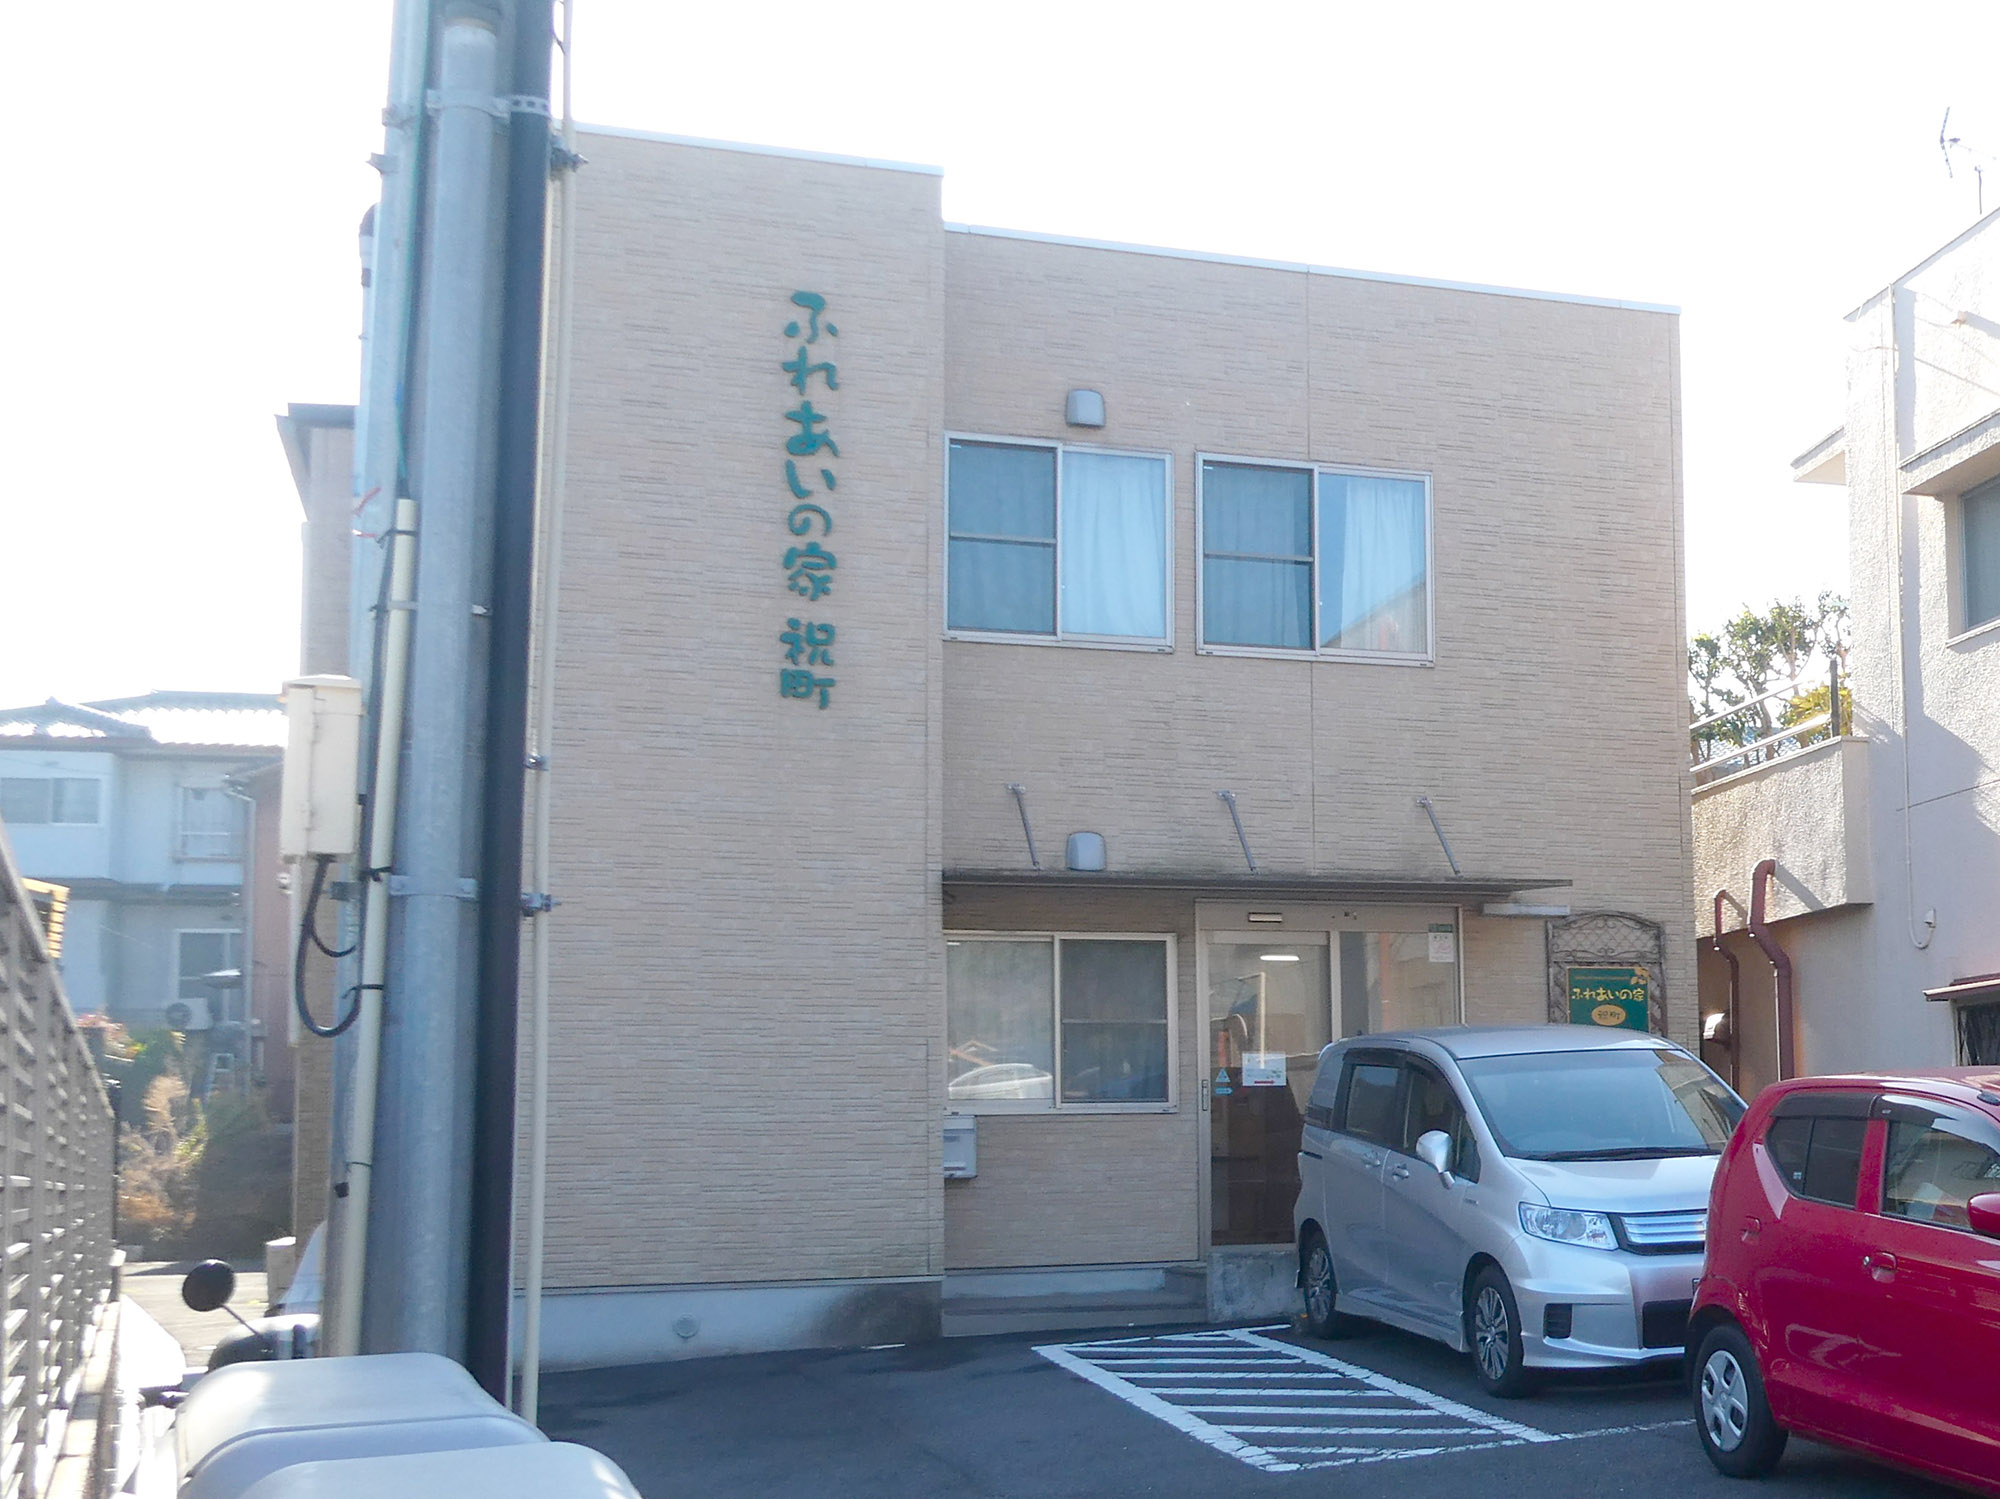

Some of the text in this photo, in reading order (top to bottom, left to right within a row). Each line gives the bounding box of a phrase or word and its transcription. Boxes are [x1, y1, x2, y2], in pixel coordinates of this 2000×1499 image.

[779, 290, 839, 710] ふれあいの家 祝町
